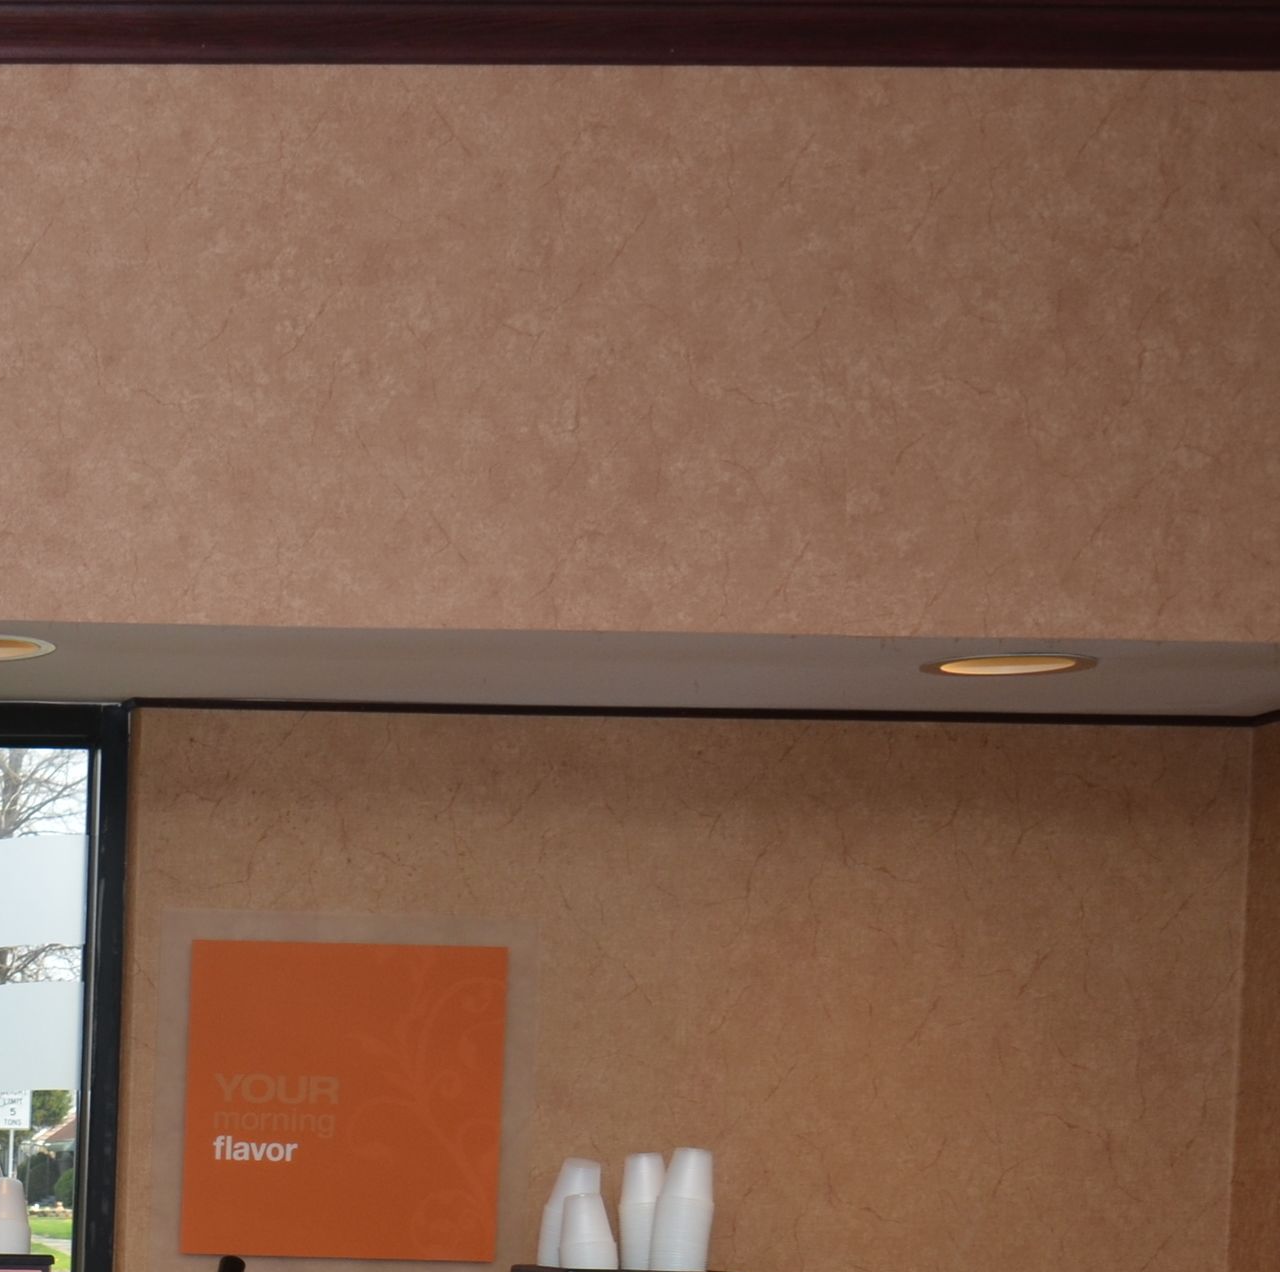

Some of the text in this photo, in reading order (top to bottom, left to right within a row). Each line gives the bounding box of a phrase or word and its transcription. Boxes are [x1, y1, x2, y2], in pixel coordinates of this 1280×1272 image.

[214, 1073, 340, 1104] YOUR
[9, 1107, 17, 1116] 5
[213, 1109, 336, 1139] morning
[213, 1135, 299, 1162] flavor
